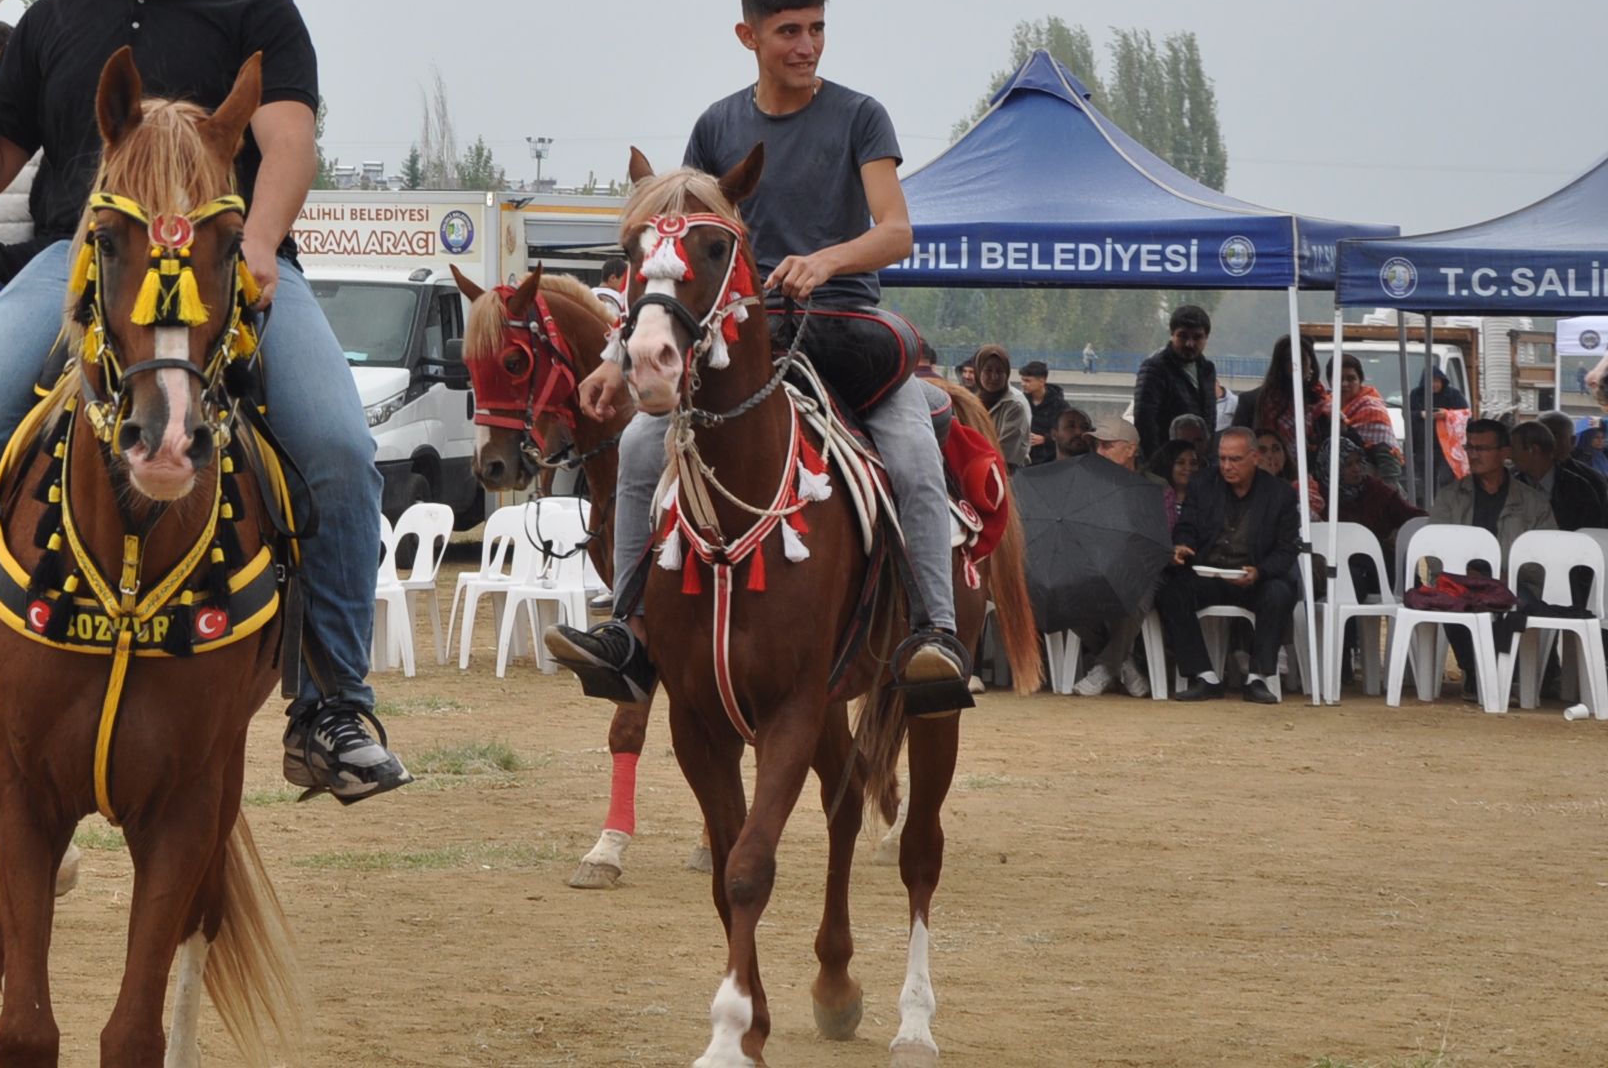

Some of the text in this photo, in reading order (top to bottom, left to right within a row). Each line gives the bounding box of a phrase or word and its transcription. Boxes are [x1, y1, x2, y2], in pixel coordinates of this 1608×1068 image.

[297, 203, 430, 222] ALİHLİ BELEDİYESİ
[291, 229, 436, 256] KRAM ARACI
[980, 237, 1198, 273] BELEDİYESİ
